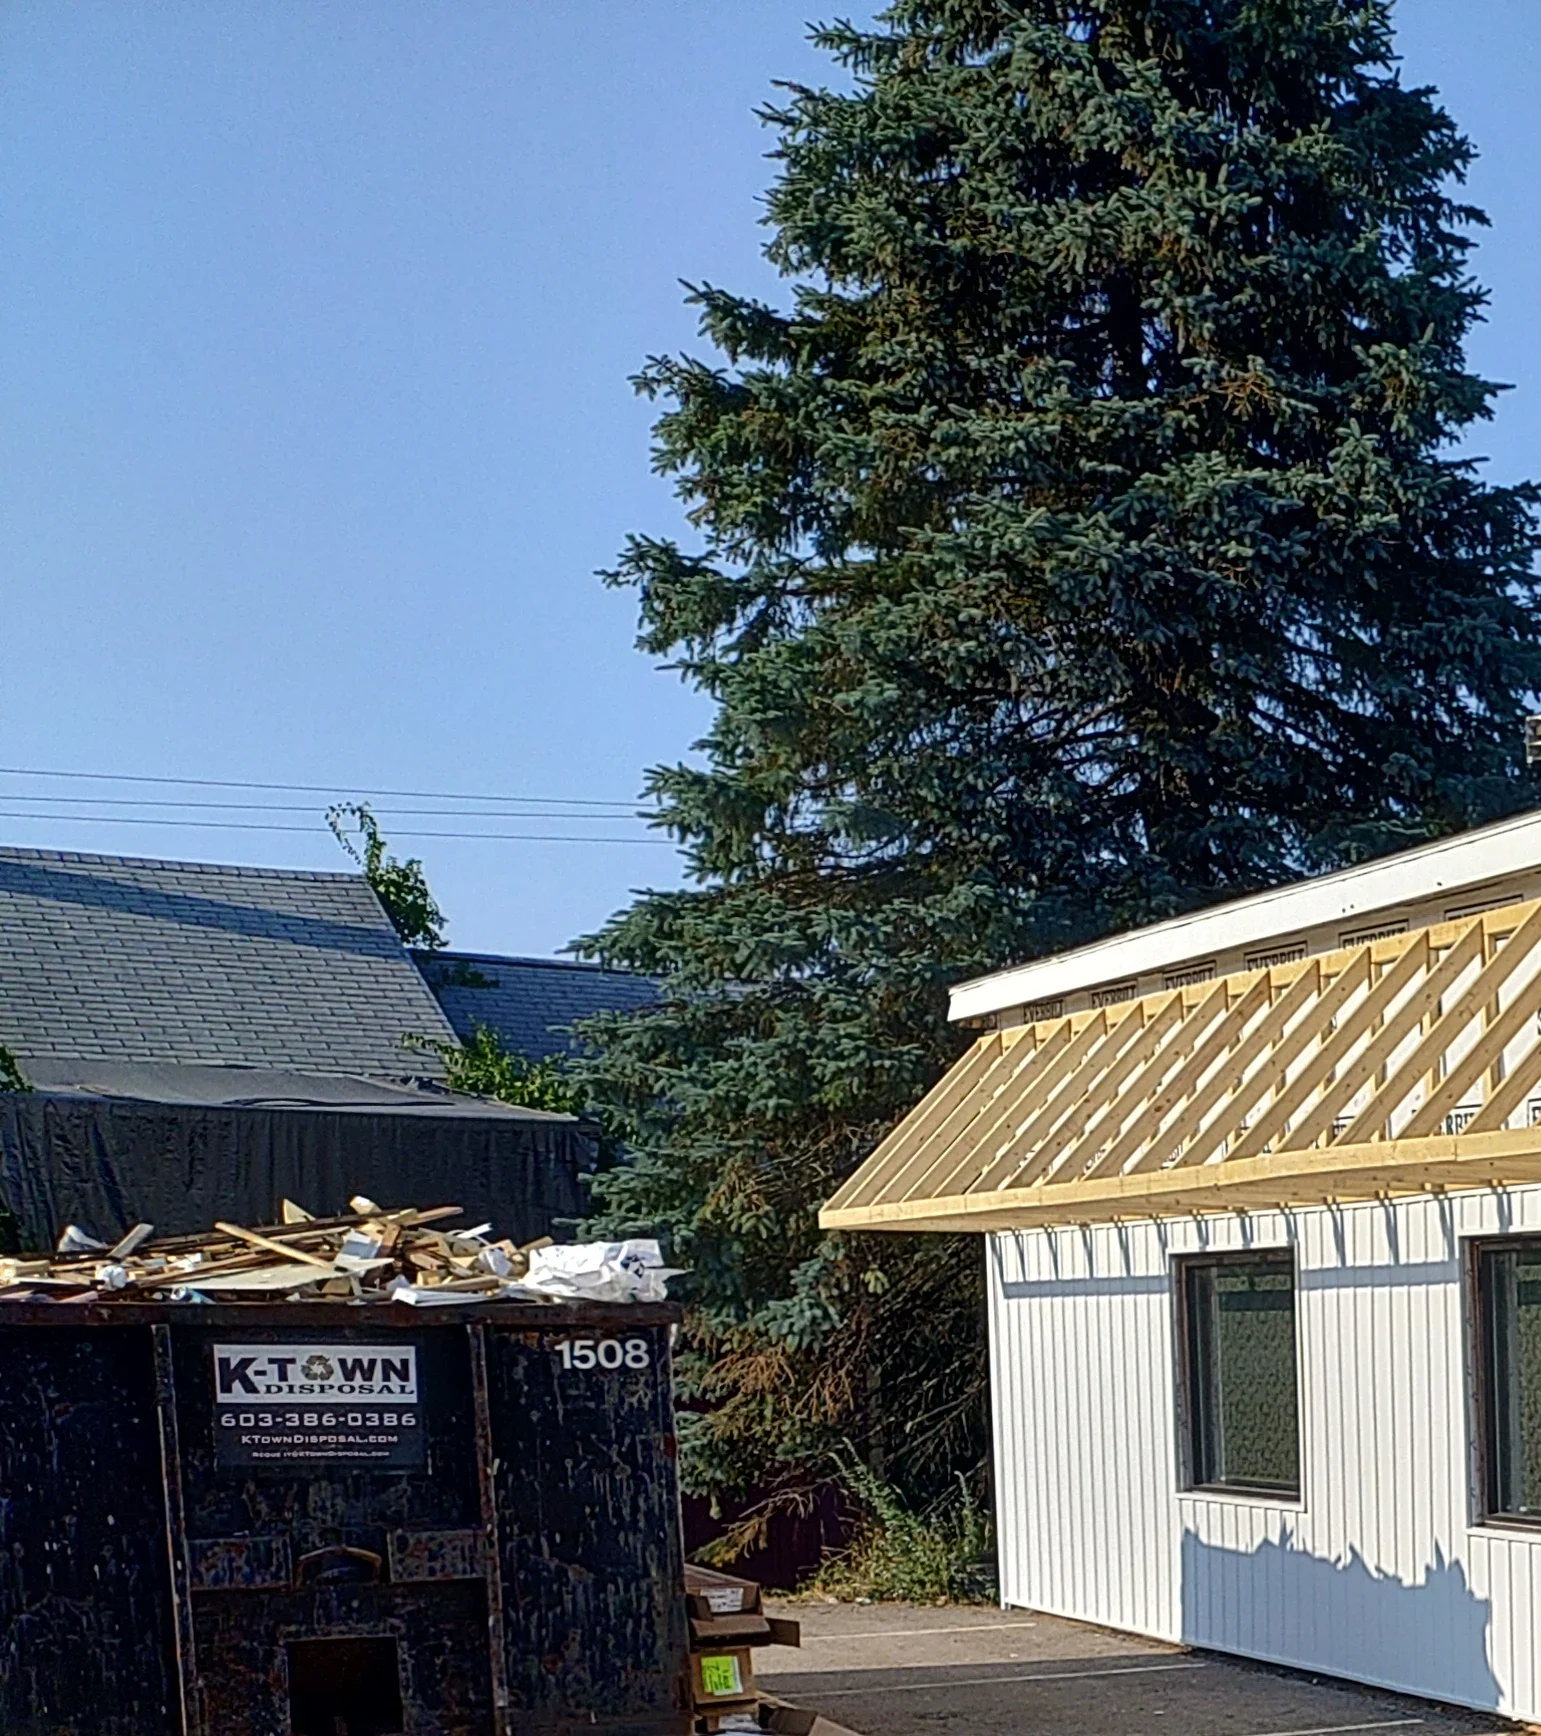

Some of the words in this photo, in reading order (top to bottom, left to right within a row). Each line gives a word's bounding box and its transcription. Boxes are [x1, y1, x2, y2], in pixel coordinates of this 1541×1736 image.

[554, 1339, 650, 1370] 1508
[264, 1383, 415, 1395] DISPOSAL
[220, 1412, 416, 1427] 603-386-0386
